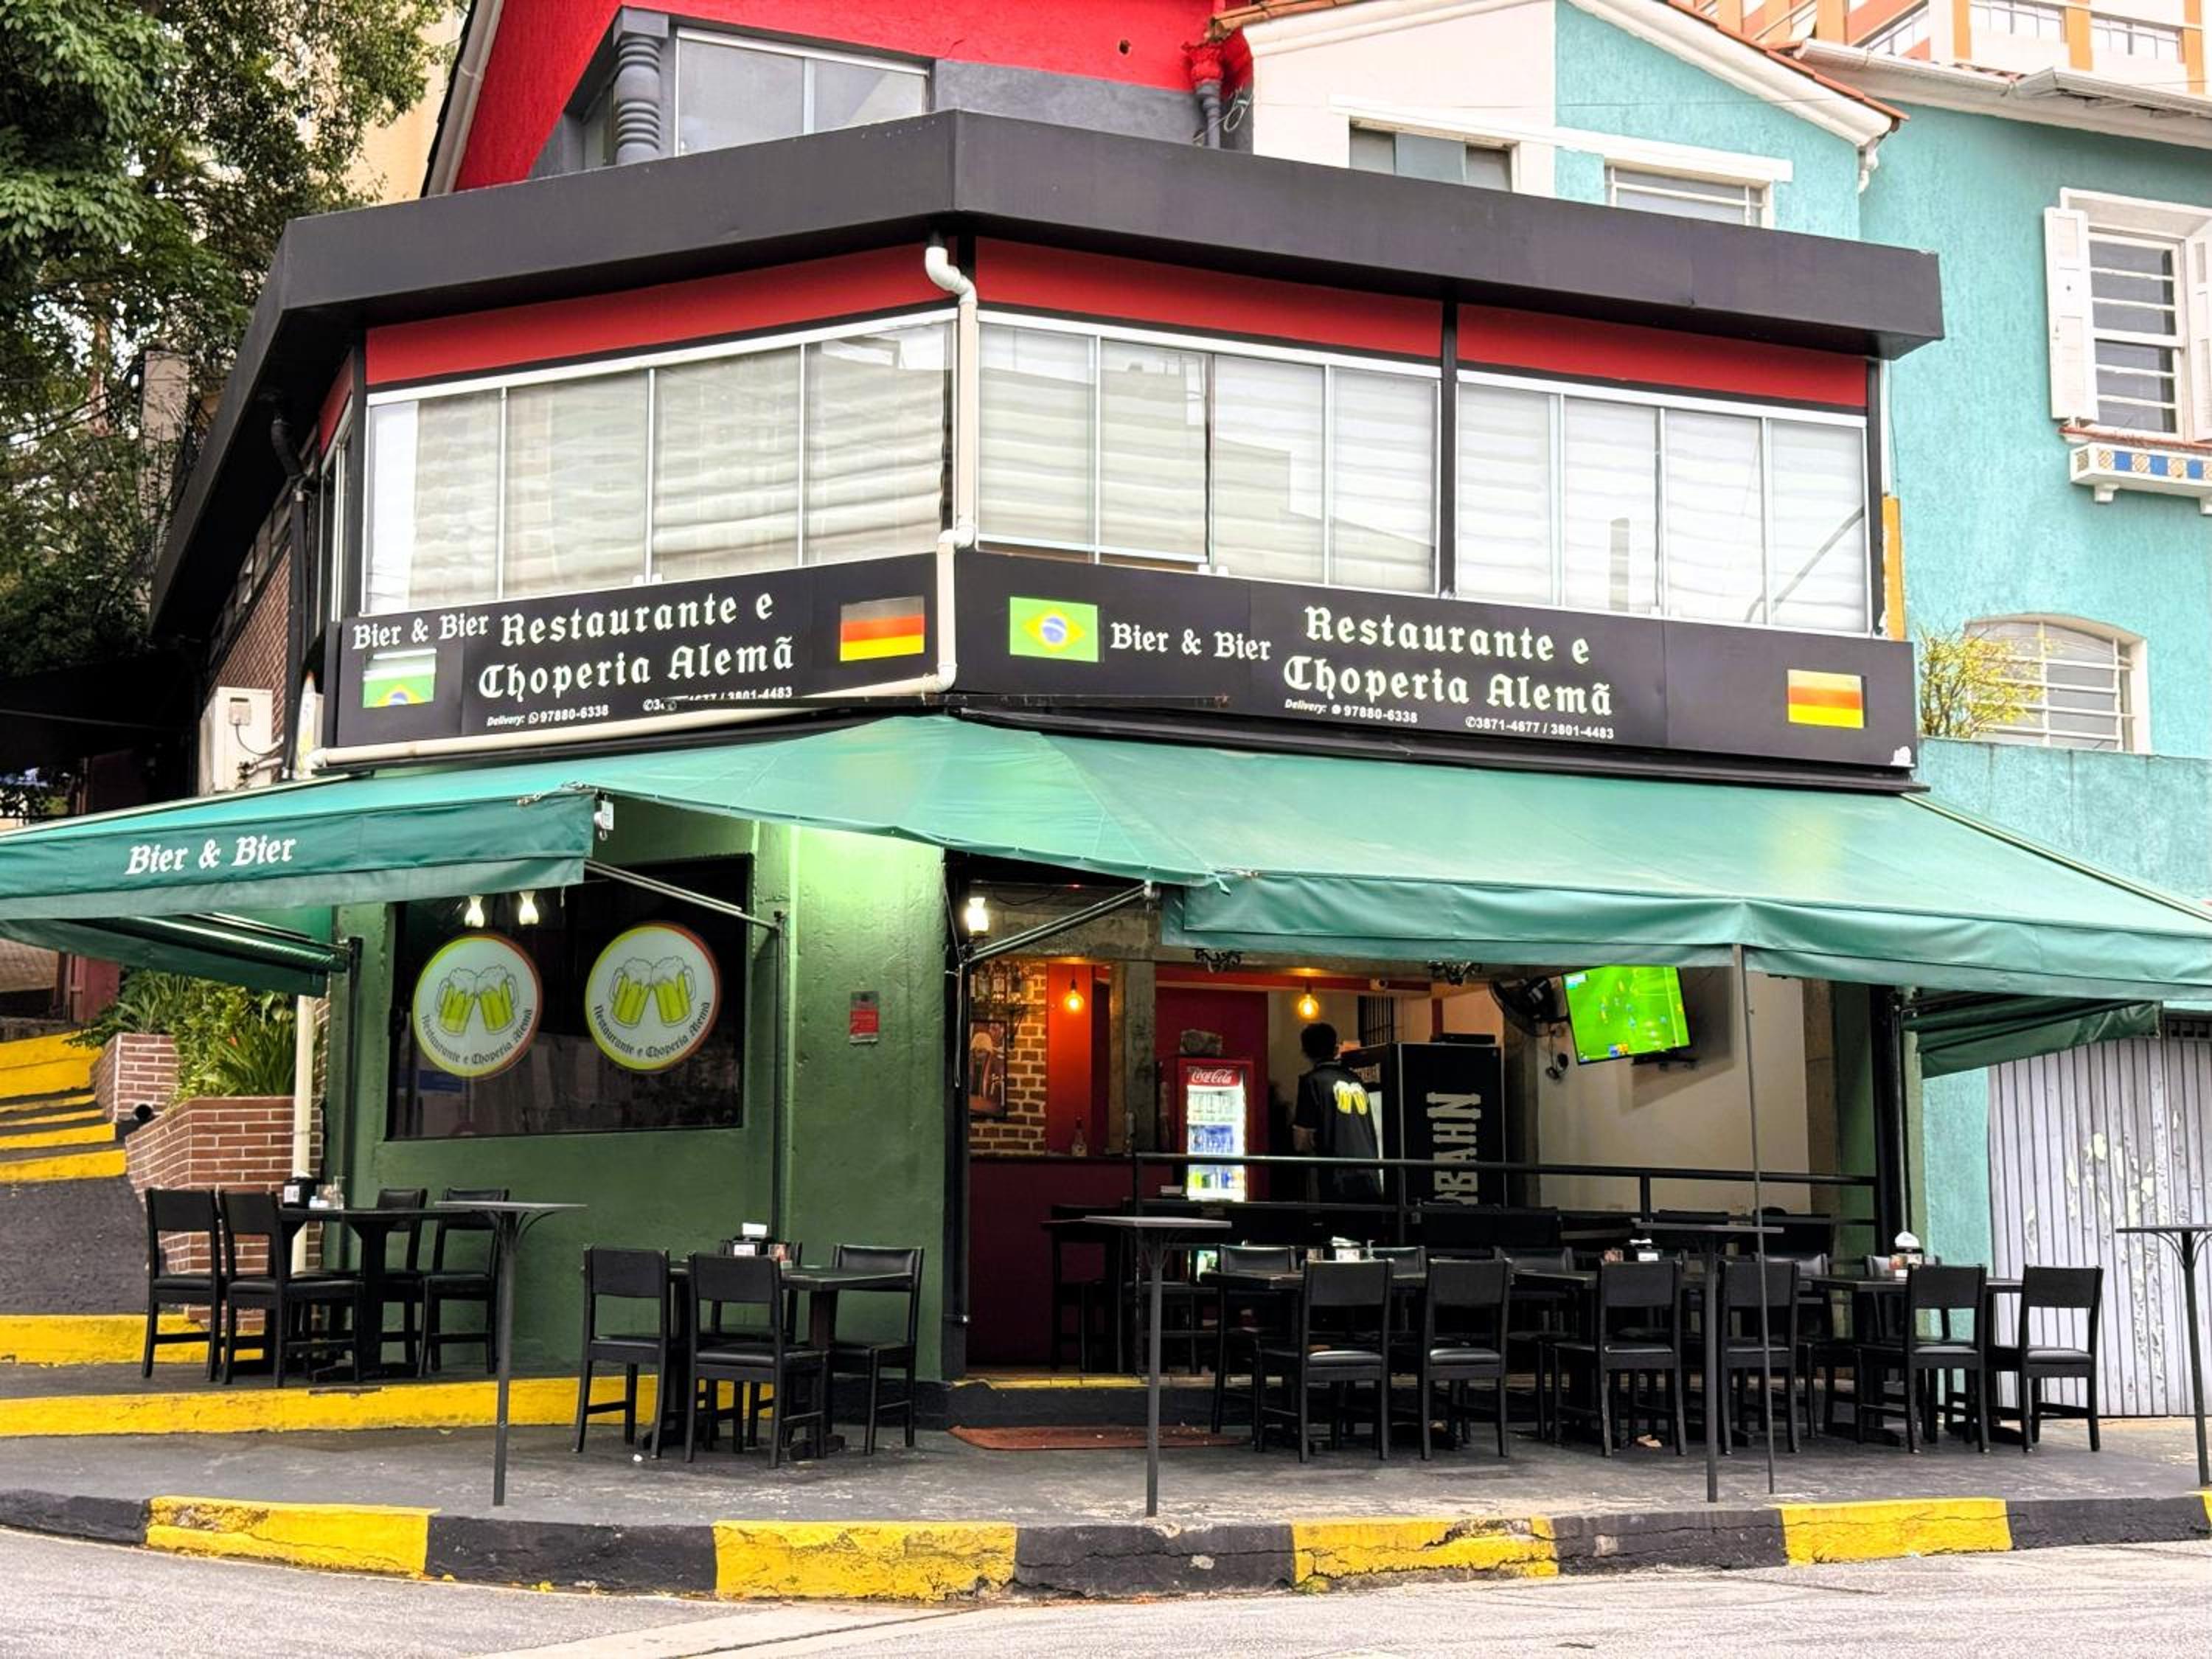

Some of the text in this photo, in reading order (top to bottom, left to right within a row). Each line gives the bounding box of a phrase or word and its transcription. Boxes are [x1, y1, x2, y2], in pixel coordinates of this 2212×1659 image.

[352, 613, 489, 650] Bier & Bier
[500, 592, 773, 647] Restaurante e
[1304, 605, 1589, 664] Restaurante e
[1110, 622, 1272, 661] Bier & Bier
[479, 651, 652, 703] Choperia
[667, 636, 793, 681] Alemã
[1284, 654, 1613, 716] Choperia Alemã
[486, 704, 610, 727] Delivery: 97880-6338
[1284, 698, 1418, 723] Delivery: 97880-6338
[125, 835, 297, 875] Bier & Bier
